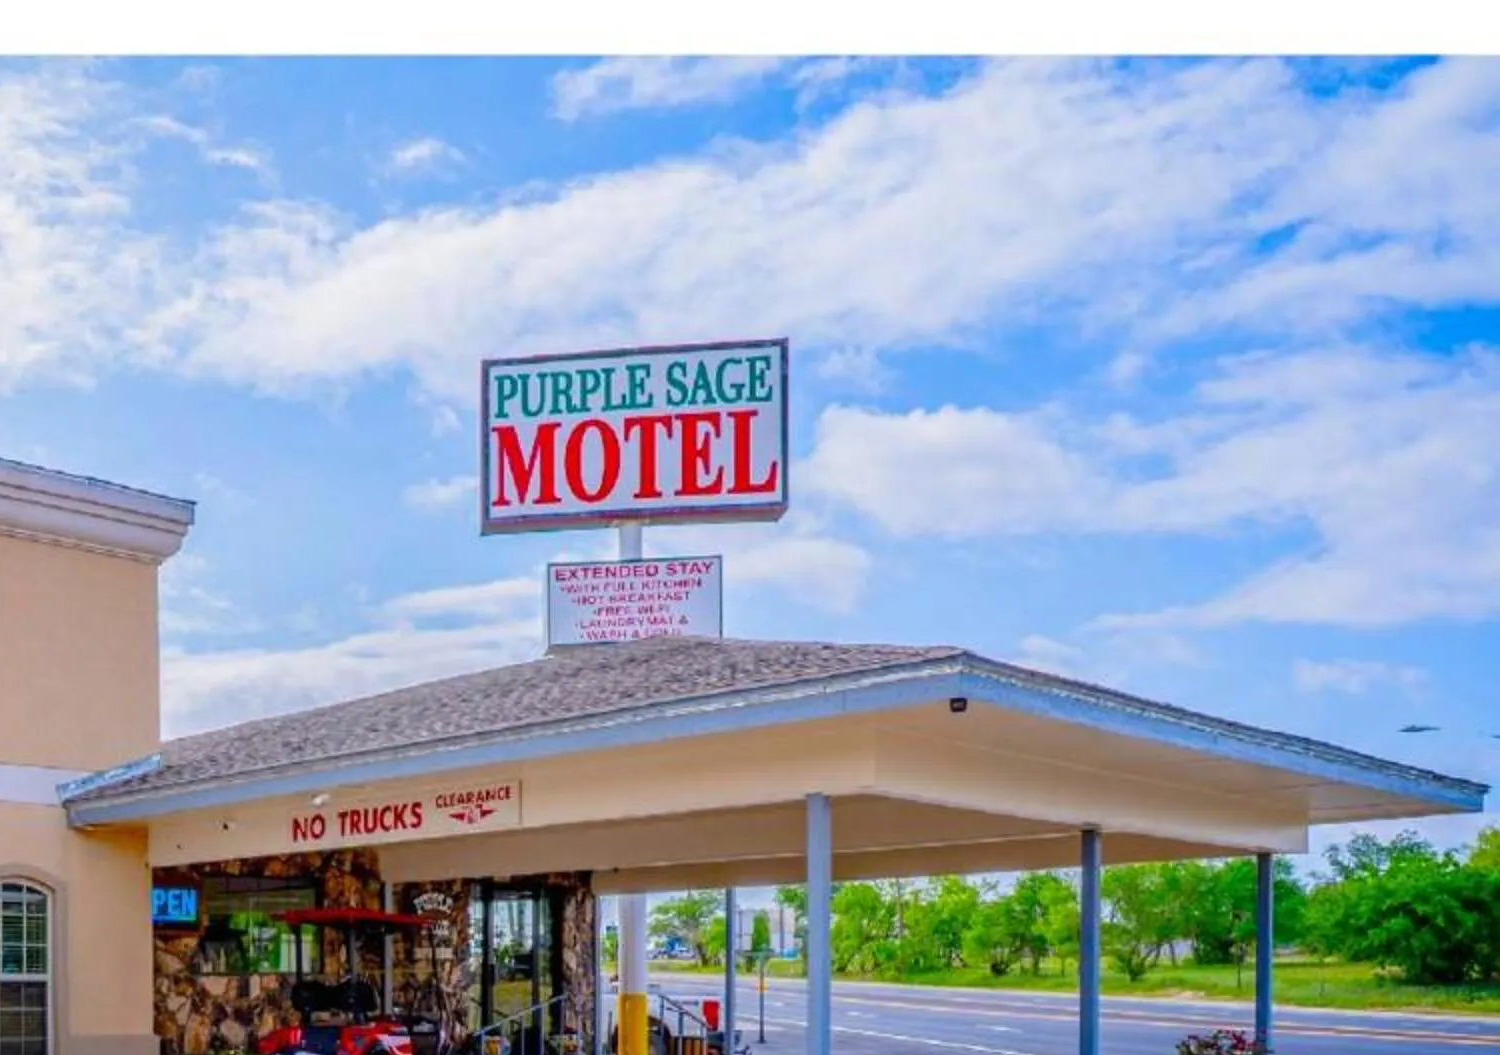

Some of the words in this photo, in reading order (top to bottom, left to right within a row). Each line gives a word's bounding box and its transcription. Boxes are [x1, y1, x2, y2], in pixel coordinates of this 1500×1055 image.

[494, 363, 654, 419] PURPLE
[666, 355, 773, 407] SAGE
[491, 409, 778, 508] MOTEL
[554, 564, 659, 582] EXTENDED
[665, 561, 713, 577] STAY
[603, 580, 636, 592] FULL
[641, 578, 702, 591] KITCHEN
[577, 595, 603, 606] HOT
[609, 591, 690, 604] BREAKFAST
[435, 785, 512, 809] CLEARANCE
[292, 815, 325, 843] NO
[338, 801, 422, 837] TRUCKS
[151, 888, 197, 916] PEN
